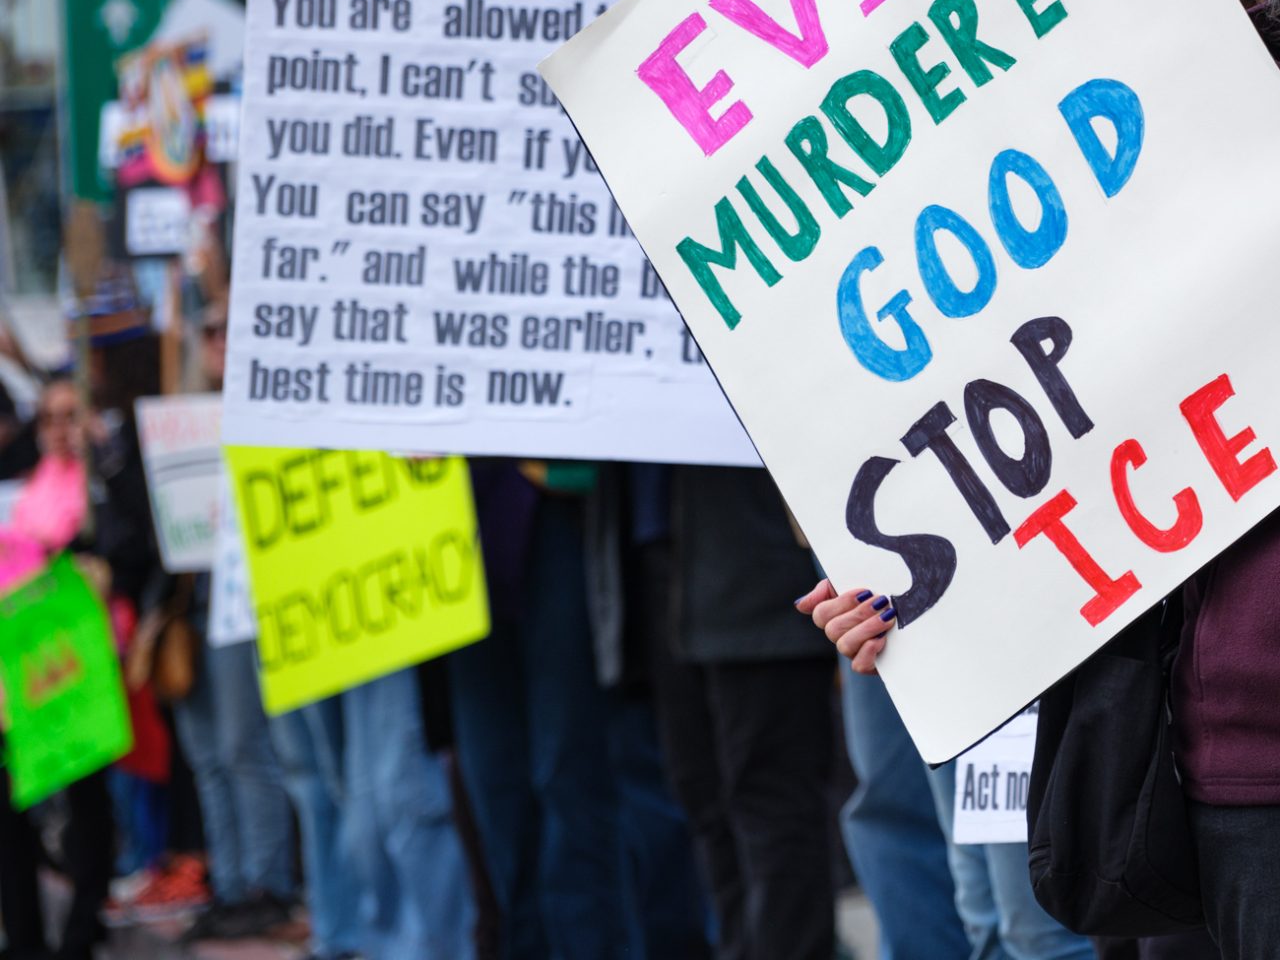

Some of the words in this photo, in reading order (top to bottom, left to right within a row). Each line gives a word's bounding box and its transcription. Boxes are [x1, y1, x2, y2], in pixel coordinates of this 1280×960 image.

[266, 49, 368, 98] point,
[380, 54, 391, 96] I
[402, 59, 496, 102] can't
[266, 119, 331, 161] you
[342, 115, 403, 159] did.
[415, 118, 497, 163] Even
[522, 128, 552, 171] if
[562, 137, 601, 180] yo
[252, 174, 319, 218] You
[346, 190, 409, 226] can
[421, 192, 485, 234] say
[836, 77, 1146, 383] GOOD
[362, 245, 426, 286] and
[453, 253, 549, 296] while
[562, 255, 620, 298] the
[253, 304, 319, 346] say
[332, 300, 409, 343] that
[434, 312, 509, 349] was
[248, 359, 331, 403] best
[345, 362, 424, 406] time
[434, 365, 466, 408] is
[486, 369, 573, 408] now.
[845, 315, 1095, 630] STOP
[1013, 372, 1279, 628] ICE
[961, 763, 1000, 811] Act
[1005, 771, 1030, 812] no
